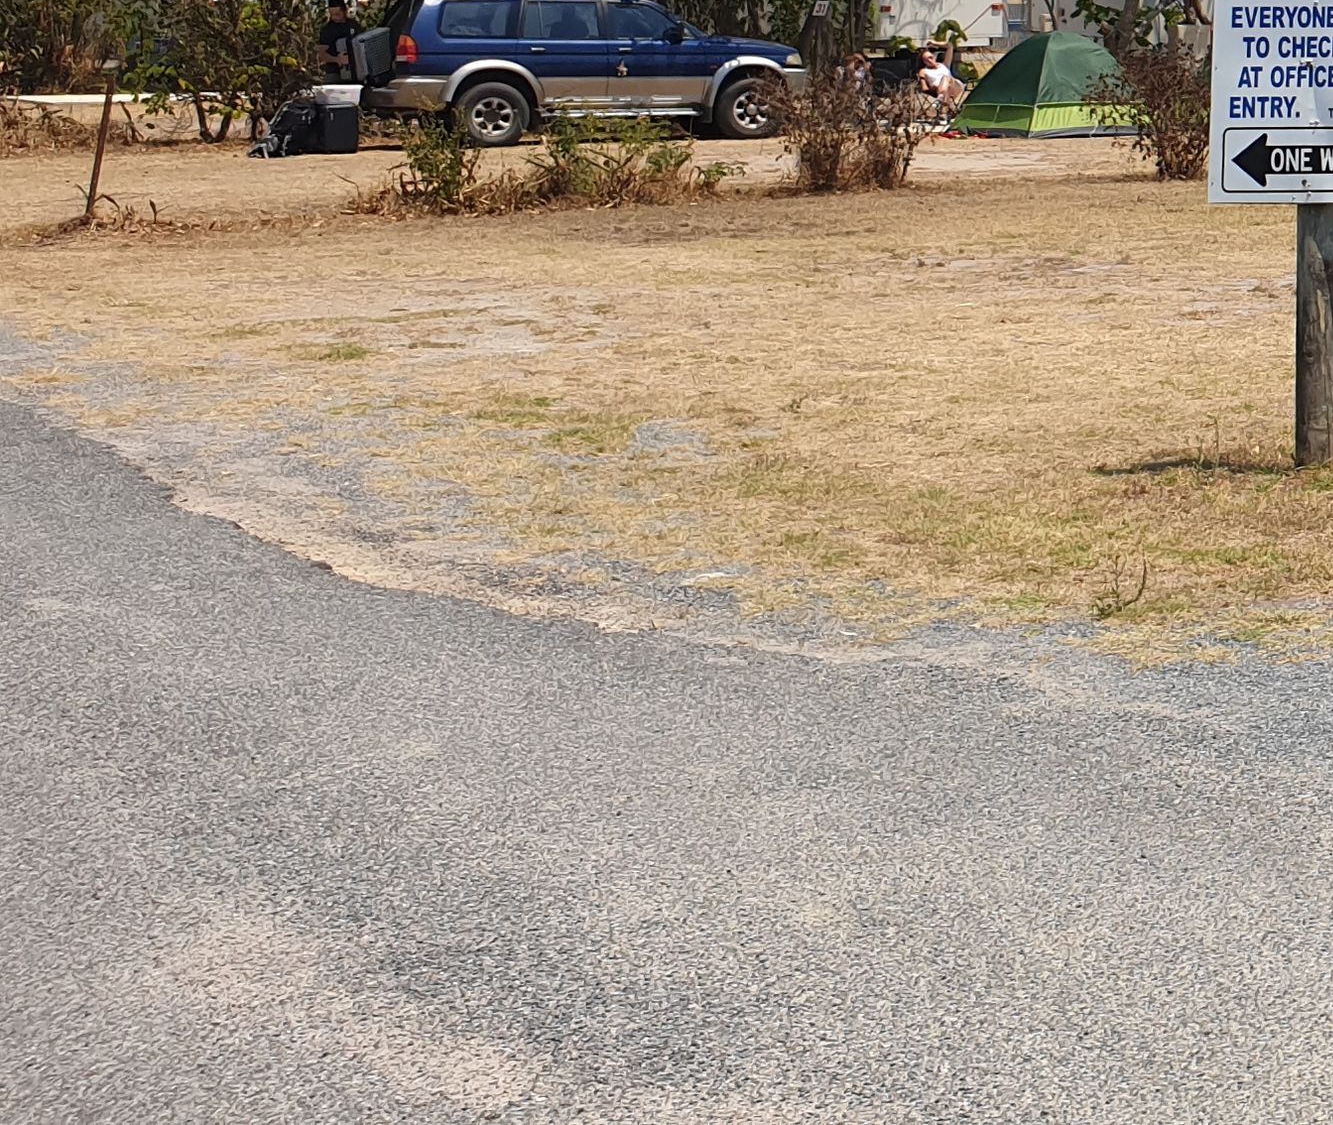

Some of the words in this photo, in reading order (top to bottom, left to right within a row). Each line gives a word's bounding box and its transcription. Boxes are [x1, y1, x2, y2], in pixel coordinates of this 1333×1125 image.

[1242, 36, 1270, 58] TO
[1237, 66, 1263, 88] AT
[1229, 96, 1300, 118] ENTRY.
[1270, 148, 1313, 172] ONE
